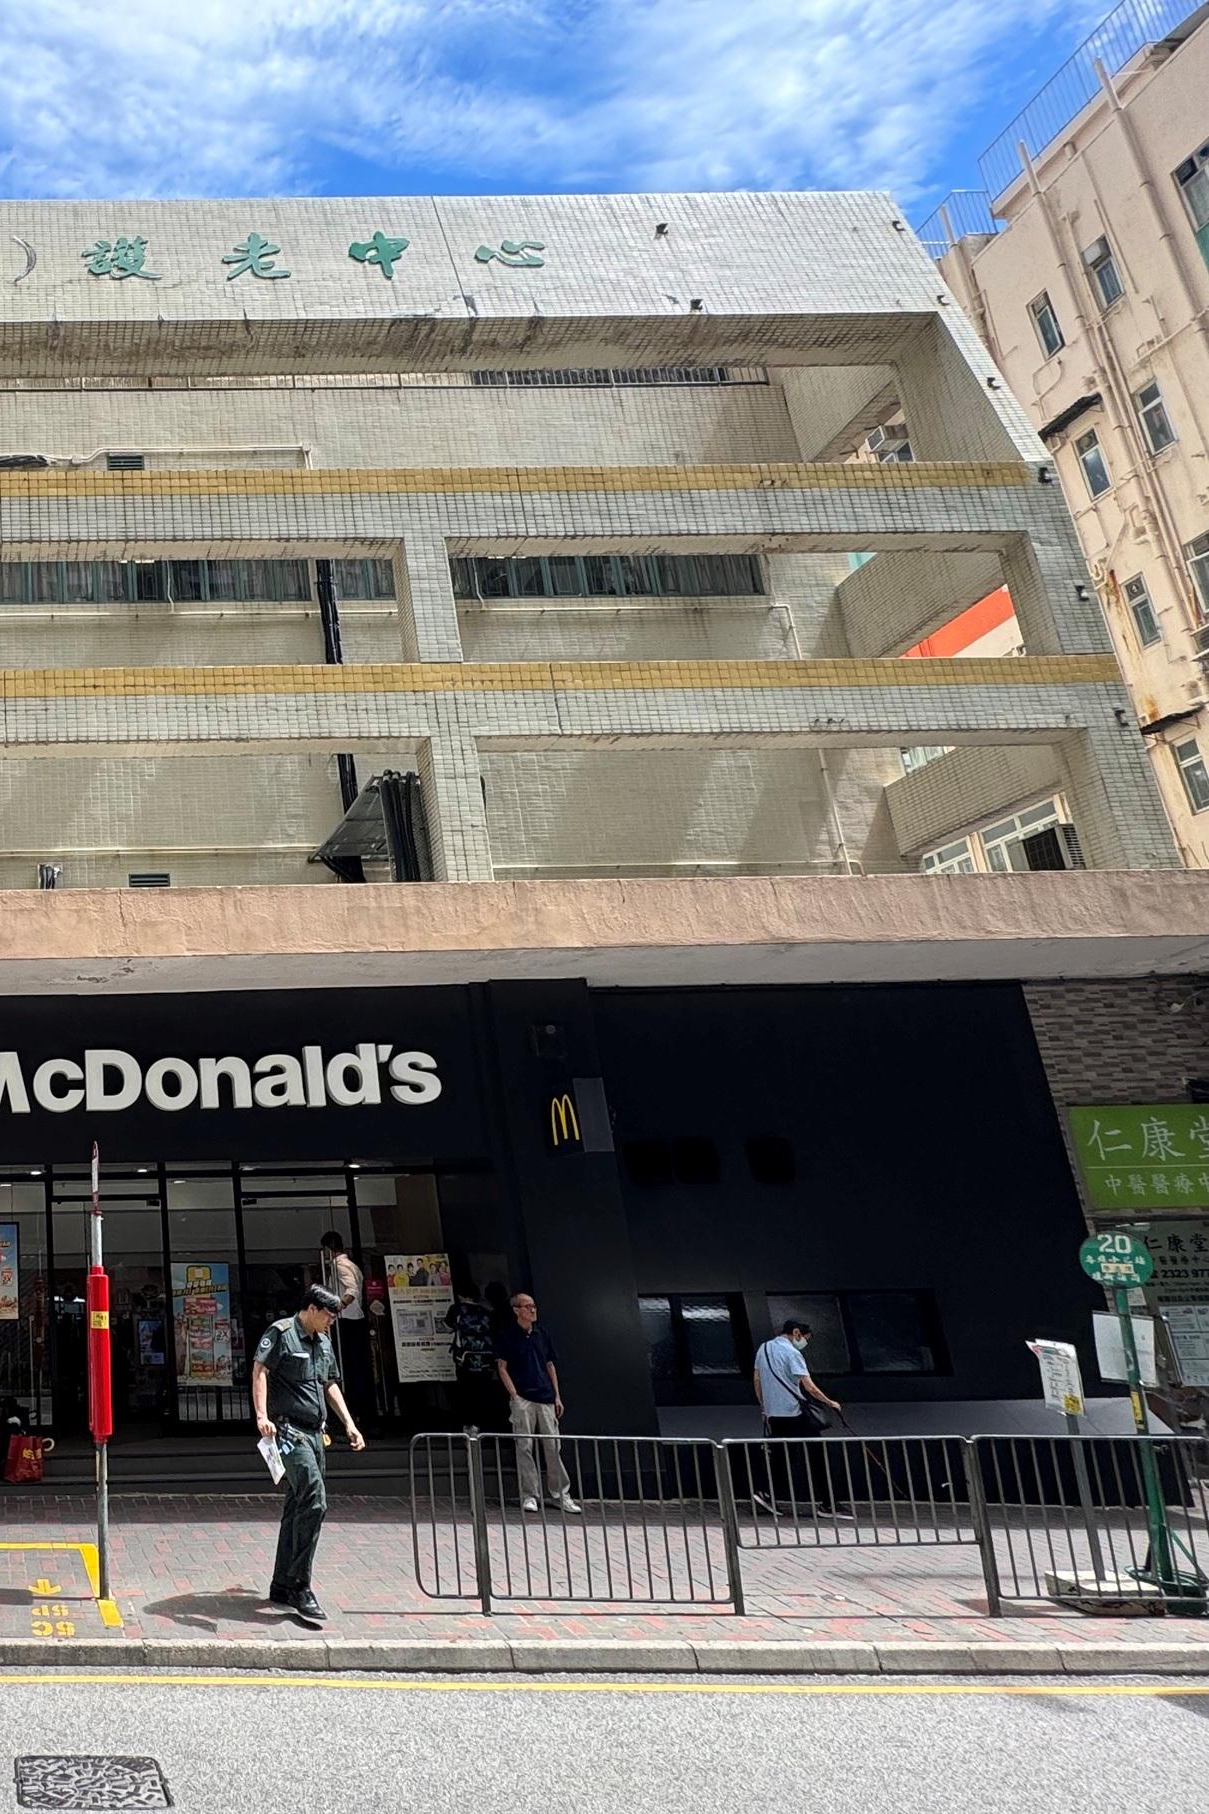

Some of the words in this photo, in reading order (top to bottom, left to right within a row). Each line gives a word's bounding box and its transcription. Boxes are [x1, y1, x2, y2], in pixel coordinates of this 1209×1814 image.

[1087, 1115, 1209, 1162] 仁康堂
[1097, 1234, 1131, 1254] 20
[1144, 1232, 1209, 1253] 仁康堂
[1160, 1269, 1189, 1278] 2323
[30, 1620, 76, 1636] 5C
